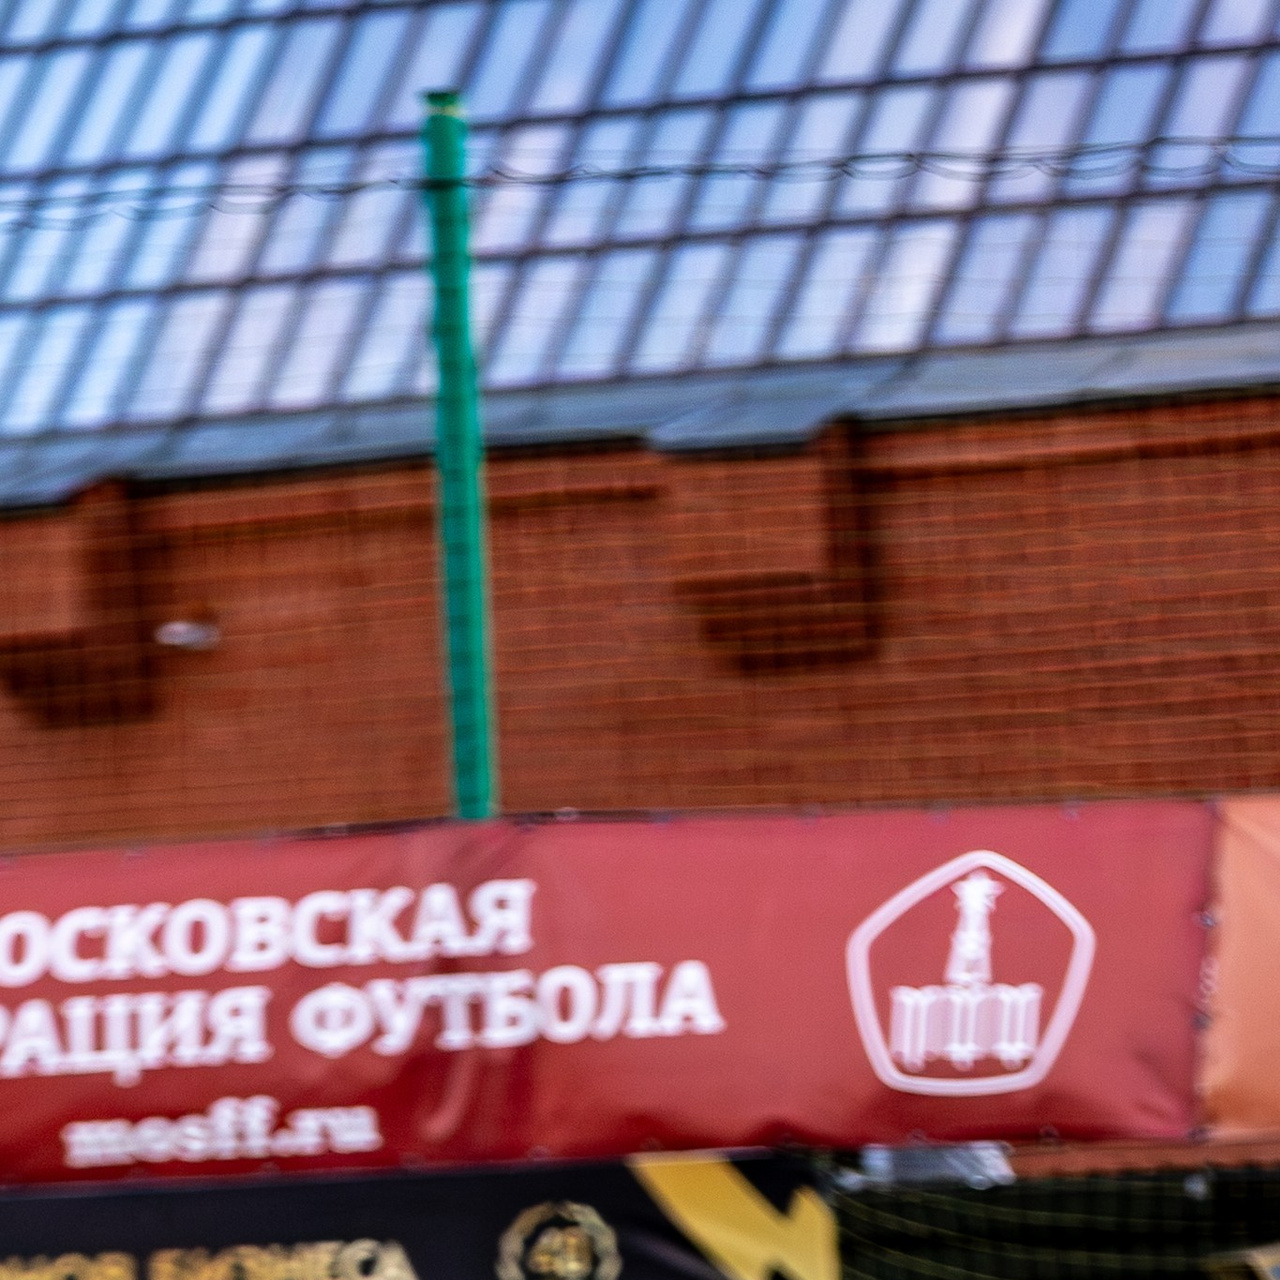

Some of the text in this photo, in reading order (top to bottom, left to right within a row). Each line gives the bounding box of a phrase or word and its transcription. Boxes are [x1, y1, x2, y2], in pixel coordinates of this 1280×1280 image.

[0, 878, 537, 988] ОСКОВСКАЯ
[0, 960, 727, 1088] АЦИЯ ФУТБОЛА
